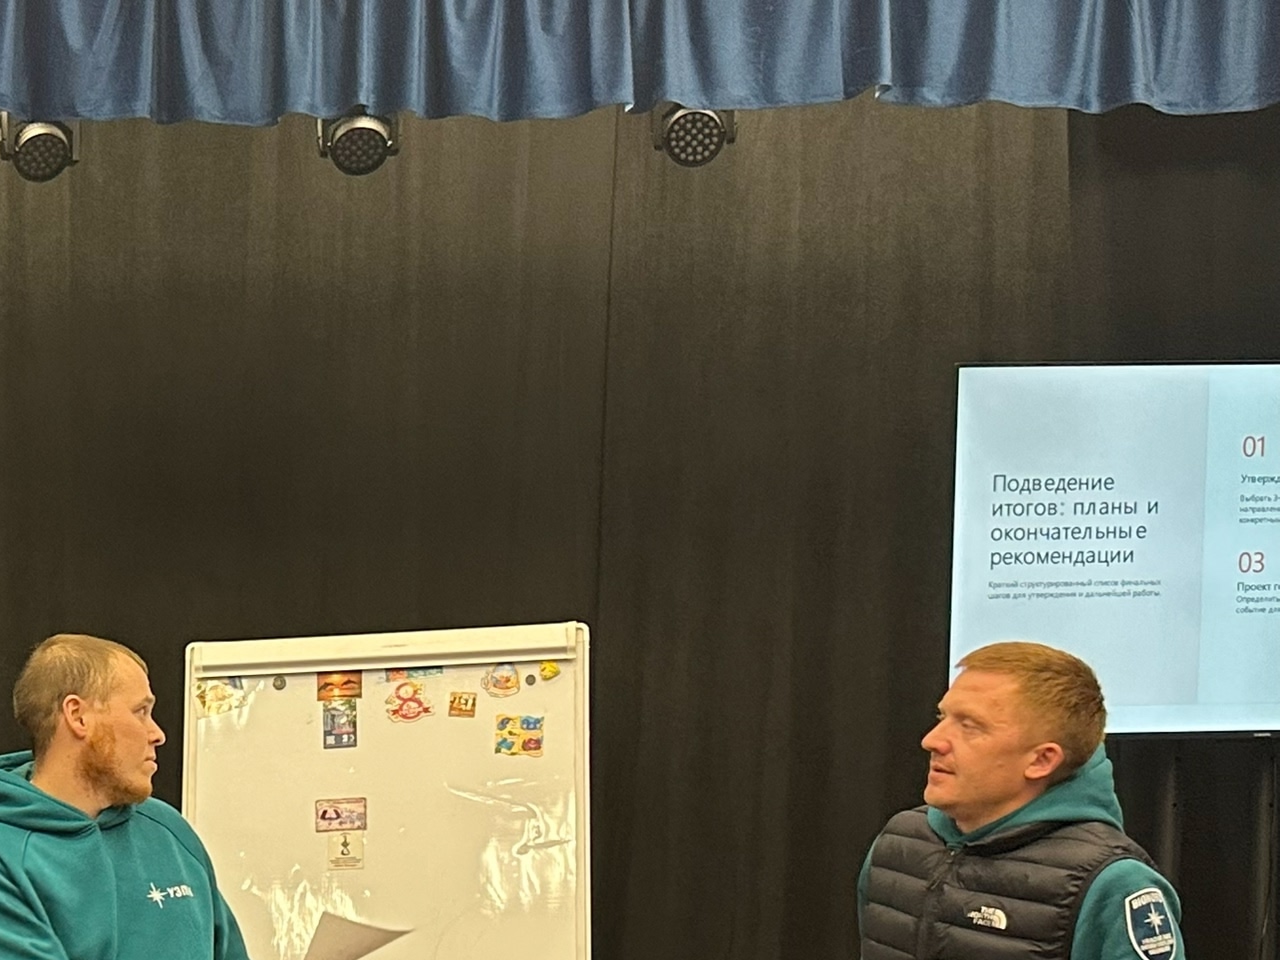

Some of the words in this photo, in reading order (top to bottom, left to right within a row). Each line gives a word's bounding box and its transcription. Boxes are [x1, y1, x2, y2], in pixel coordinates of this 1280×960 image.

[1242, 435, 1265, 458] 01
[992, 473, 1116, 495] Подведение
[991, 501, 1066, 517] итогов:
[1072, 500, 1138, 515] планы
[1147, 500, 1159, 515] и
[990, 524, 1148, 542] окончательные
[989, 549, 1135, 571] рекомендации
[1238, 551, 1265, 574] 03
[1236, 581, 1271, 593] Проект
